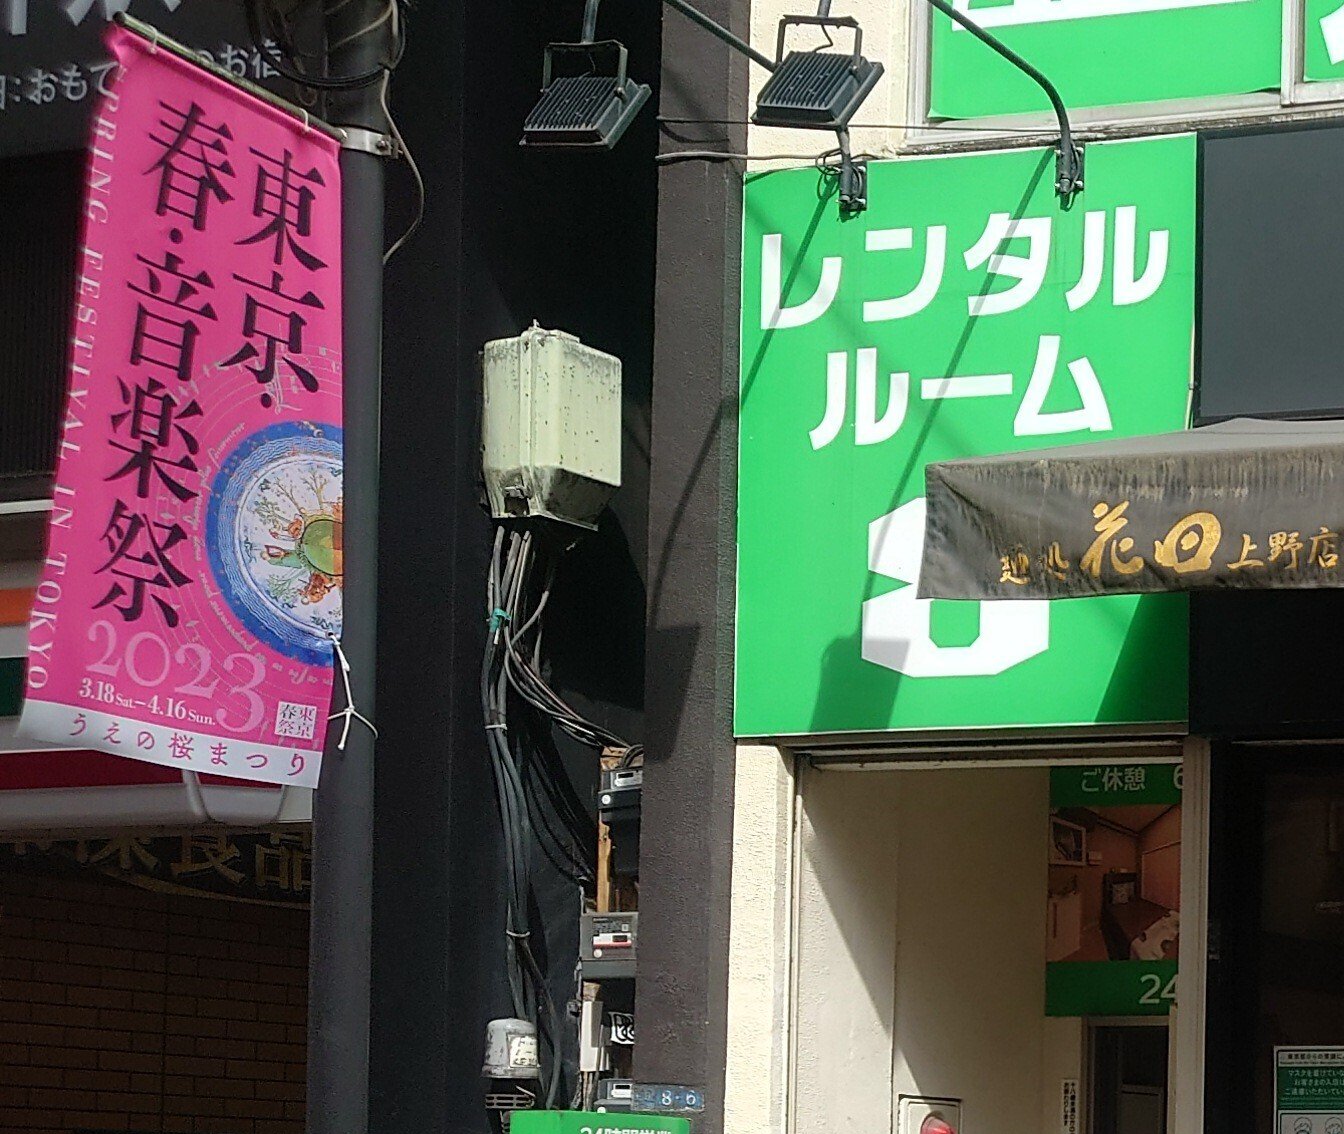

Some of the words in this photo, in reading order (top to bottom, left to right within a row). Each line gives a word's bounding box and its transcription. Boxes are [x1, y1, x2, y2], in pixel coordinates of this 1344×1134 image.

[760, 204, 1171, 331] レンタル
[809, 335, 1113, 451] ルーム
[27, 553, 66, 692] TOKYO
[86, 619, 267, 733] 2023
[70, 712, 306, 777] うえの桜まつり
[1080, 767, 1146, 793] ご休憩
